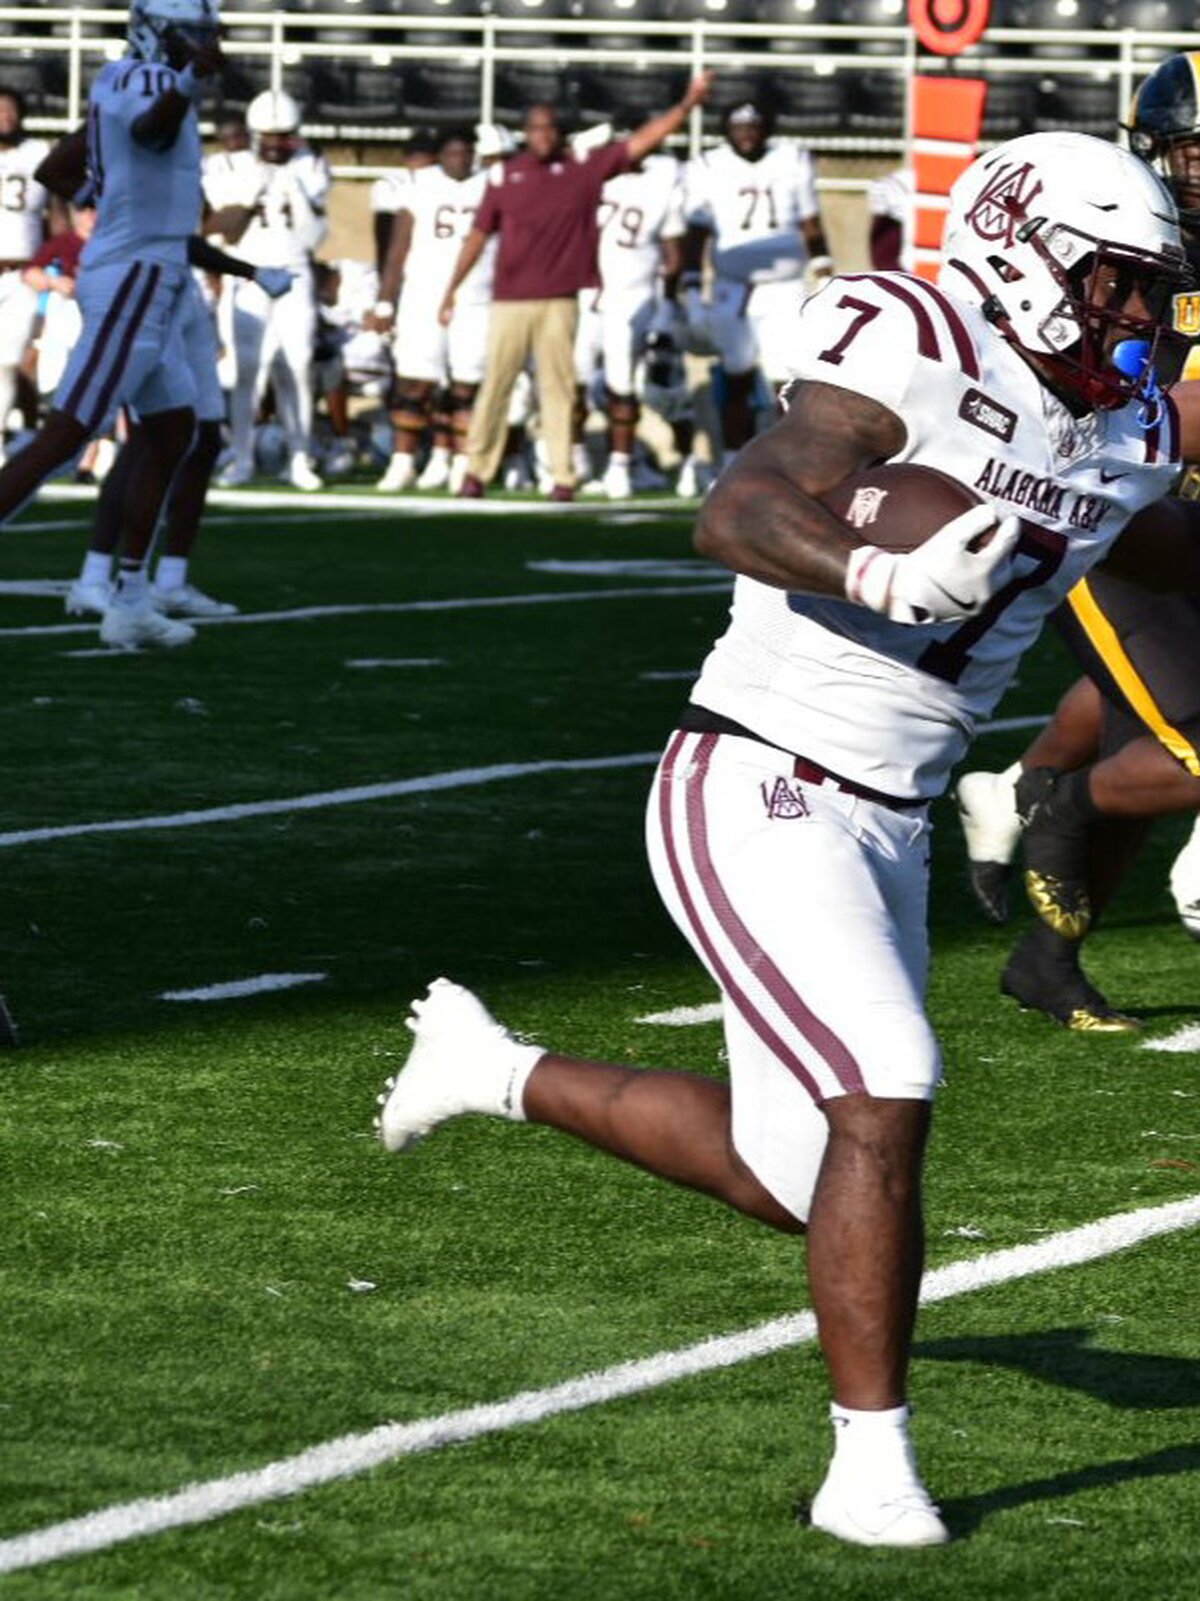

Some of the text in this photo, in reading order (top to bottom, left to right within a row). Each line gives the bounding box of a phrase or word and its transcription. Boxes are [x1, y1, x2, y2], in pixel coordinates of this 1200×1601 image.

[599, 199, 644, 248] 79
[738, 187, 779, 230] 71
[818, 294, 882, 366] 7
[916, 515, 1069, 686] 7
